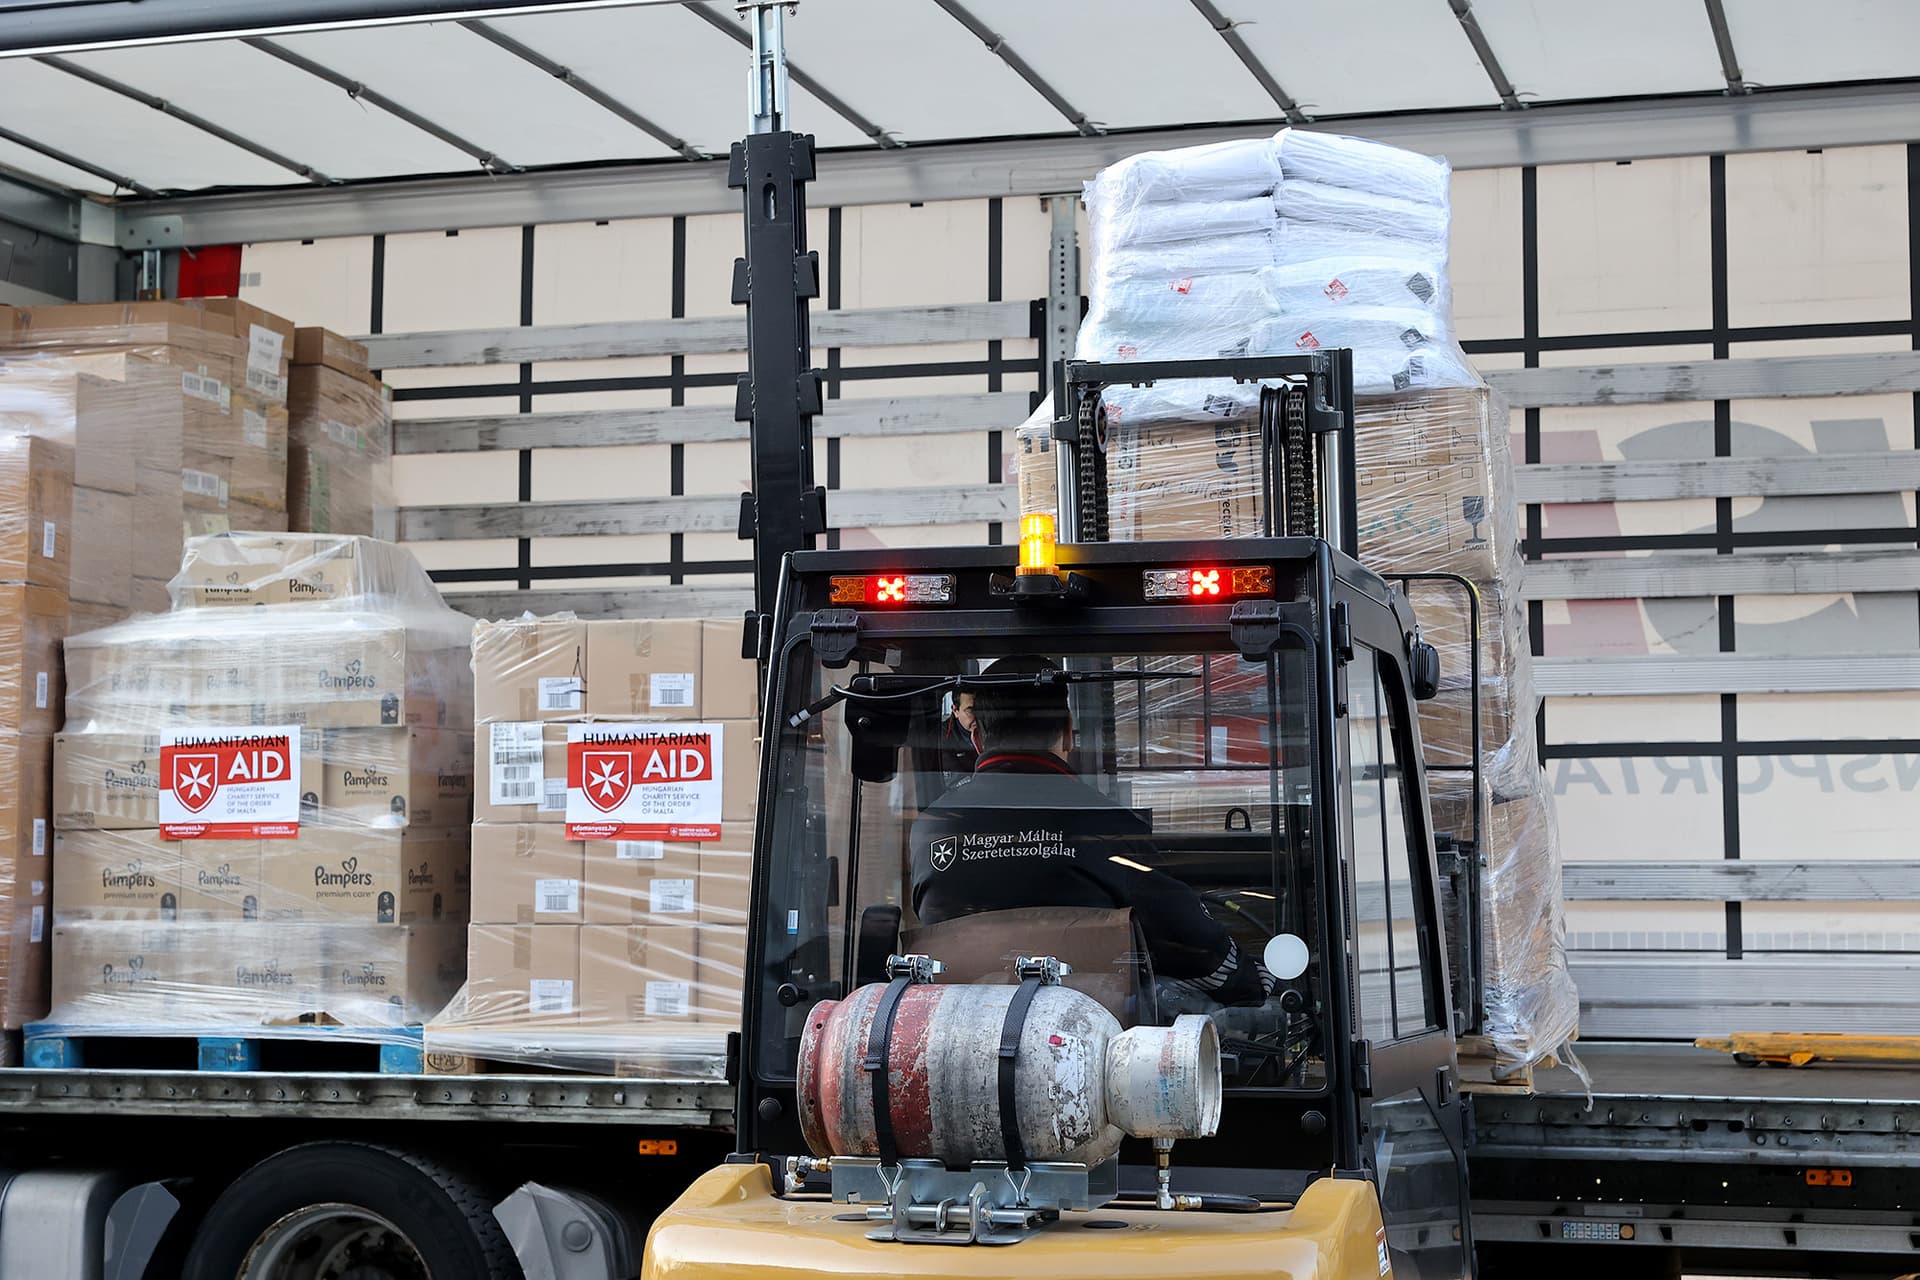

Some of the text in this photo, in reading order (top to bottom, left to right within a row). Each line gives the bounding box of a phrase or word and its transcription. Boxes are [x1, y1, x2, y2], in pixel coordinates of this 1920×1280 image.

[319, 669, 376, 690] Pampers
[174, 735, 286, 749] HUMANITARIAN
[583, 732, 707, 747] HUMANITARIAN
[227, 751, 284, 780] AID
[642, 749, 705, 779] AID
[343, 770, 388, 787] Pampers
[962, 829, 1064, 849] Magyar Máltai
[961, 843, 1077, 861] Szeretetszolgálat
[102, 868, 156, 889] Pampers
[198, 870, 242, 887] Pampers
[314, 865, 373, 889] Pampers
[315, 891, 352, 899] premium
[236, 966, 293, 986] Pampers
[341, 968, 386, 986] Pampers
